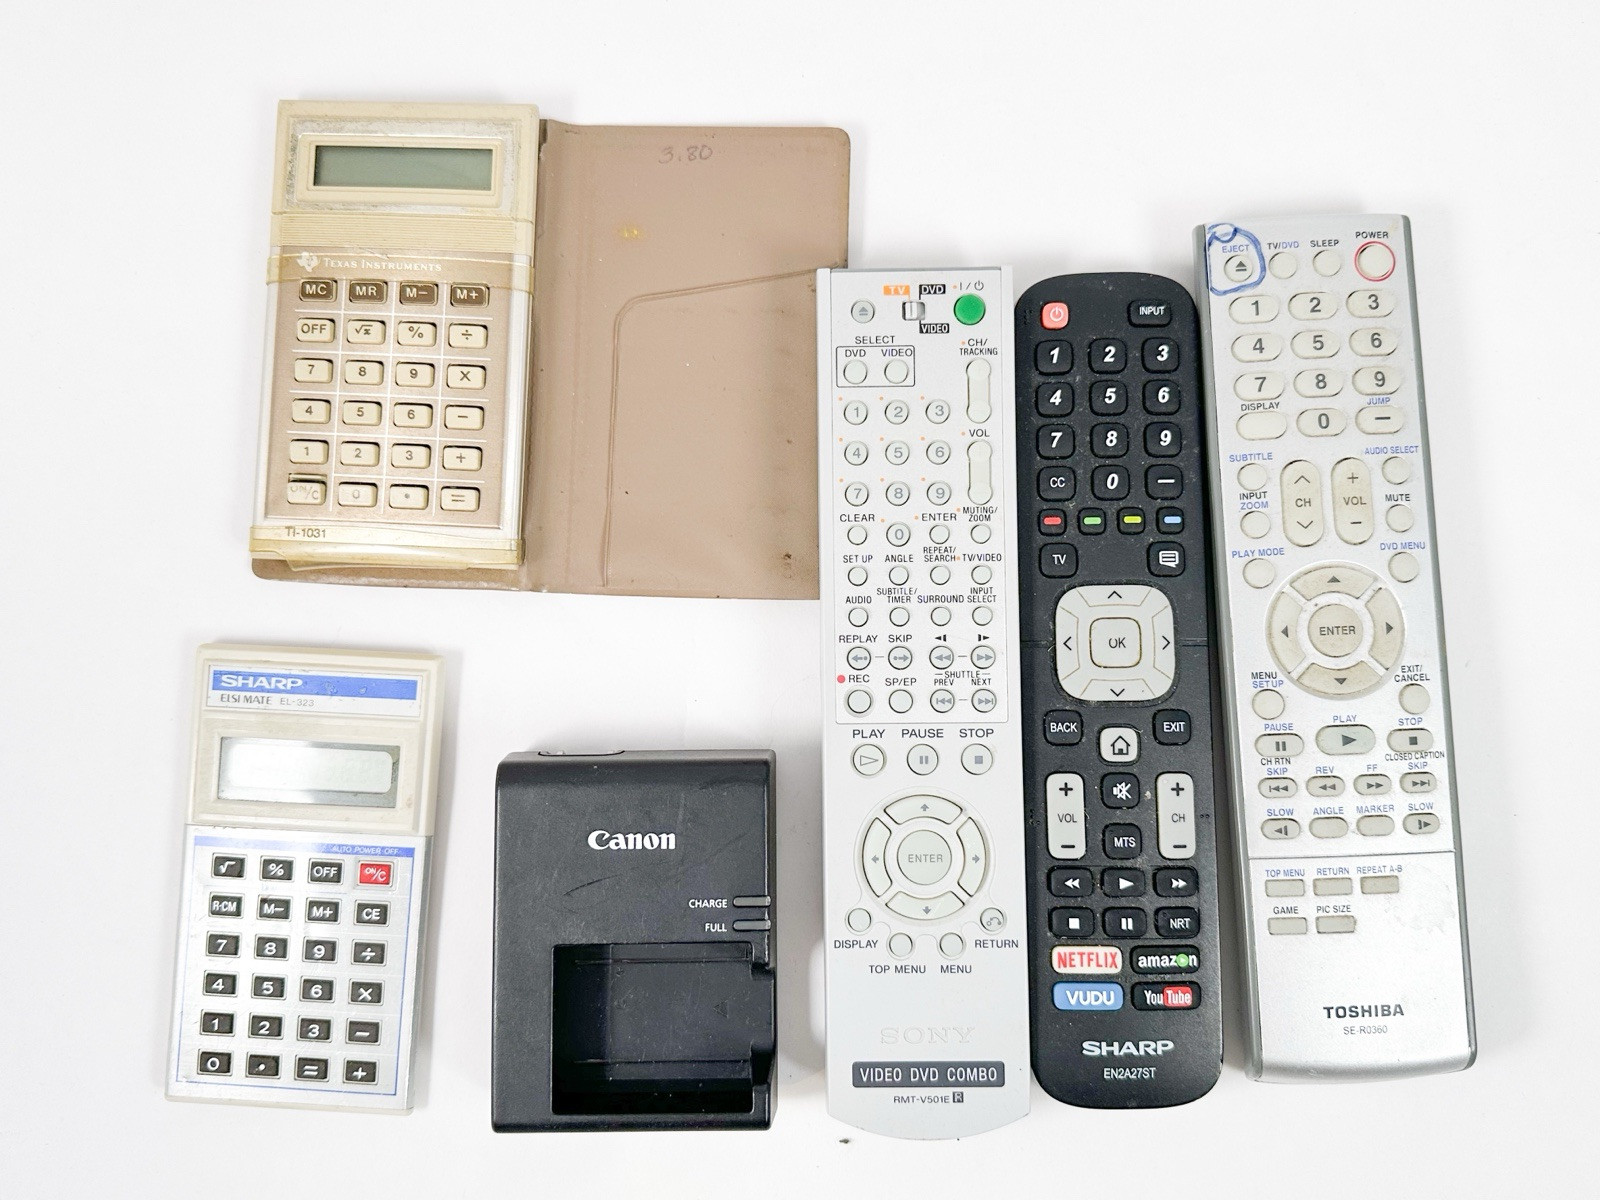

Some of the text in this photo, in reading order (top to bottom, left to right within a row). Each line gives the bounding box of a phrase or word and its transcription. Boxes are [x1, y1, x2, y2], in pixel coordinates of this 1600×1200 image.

[1355, 231, 1389, 239] POWER
[1267, 241, 1299, 250] TV/DVD
[1310, 240, 1339, 248] SLEEP
[1222, 245, 1250, 253] EJECT
[304, 284, 328, 294] MC
[355, 285, 378, 296] MR
[889, 286, 905, 294] TV
[922, 285, 944, 294] DVD
[1309, 297, 1321, 313] 2
[1368, 294, 1379, 310] 3
[1139, 307, 1165, 315] INPUT
[1251, 300, 1259, 316] 1
[301, 324, 326, 334] OFF
[922, 324, 949, 333] VIDEO
[855, 336, 895, 344] SELECT
[845, 349, 866, 357] DVD
[881, 349, 913, 357] VIDEO
[960, 348, 998, 356] TRACKING
[1050, 348, 1059, 363] 1
[1104, 346, 1115, 362] 2
[1157, 345, 1169, 361] 3
[308, 365, 314, 374] 7
[358, 366, 366, 376] 8
[410, 368, 418, 379] 9
[1367, 397, 1391, 405] JUMP
[1241, 402, 1280, 411] DISPLAY
[969, 429, 990, 437] VOL
[1364, 446, 1419, 455] AUDIO SELECT
[1229, 452, 1273, 462] SUBTITLE
[1050, 477, 1065, 487] CC
[1239, 491, 1267, 500] INPUT
[1240, 501, 1269, 510] ZOOM
[1295, 498, 1311, 507] CH
[1343, 497, 1367, 506] VOL
[840, 514, 875, 522] CLEAR
[285, 526, 326, 538] TI-1031
[1380, 543, 1398, 551] DVD
[1232, 548, 1285, 558] PLAY MODE
[843, 555, 873, 563] SET UP
[1052, 555, 1066, 564] TV
[917, 595, 964, 603] SURROUND
[967, 595, 997, 603] SELECT
[1320, 626, 1356, 635] ENTER
[839, 635, 878, 643] REPLAY
[1108, 637, 1126, 648] OK
[1251, 672, 1277, 680] MENU
[1394, 674, 1430, 682] CANCEL
[220, 674, 303, 690] SHARP
[885, 678, 916, 686] SP/EP
[1272, 680, 1284, 688] UP
[243, 694, 272, 705] MATE
[280, 698, 315, 707] EL-323
[1333, 715, 1357, 723] PLAY
[1398, 717, 1423, 725] STOP
[1050, 723, 1077, 732] BACK
[1163, 722, 1185, 732] EXIT
[1264, 723, 1293, 731] PAUSE
[852, 730, 885, 738] PLAY
[901, 729, 944, 738] PAUSE
[959, 729, 994, 738] STOP
[1385, 751, 1445, 761] CLOSED CAPTION
[1275, 757, 1291, 765] RTN
[1316, 766, 1334, 774] REV
[1408, 762, 1428, 770] SKIP
[1267, 767, 1288, 775] SKIP
[1313, 807, 1344, 815] ANGLE
[1356, 805, 1395, 813] MARKER
[1408, 802, 1433, 811] SLOW
[1267, 808, 1294, 816] SLOW
[1057, 814, 1077, 822] VOL
[1172, 814, 1185, 822] CH
[588, 830, 676, 850] Canon
[1114, 837, 1136, 847] MTS
[332, 845, 399, 855] AUTO POWER OFF
[908, 855, 943, 863] ENTER
[313, 866, 338, 877] OFF
[1265, 869, 1305, 877] TOP MENU
[1316, 867, 1350, 875] RETURN
[1356, 866, 1388, 874] REPEAT
[688, 899, 728, 908] CHARGE
[1273, 906, 1298, 914] GAME
[1333, 905, 1351, 913] SIZE
[363, 909, 380, 919] CE
[705, 923, 727, 932] FULL
[1170, 918, 1191, 928] NRT
[217, 939, 228, 951] 7
[834, 940, 878, 948] DISPLAY
[975, 940, 1018, 948] RETURN
[265, 943, 277, 955] 8
[313, 945, 325, 958] 9
[1057, 952, 1118, 968] NETFLIX
[869, 965, 926, 973] TOP MENU
[940, 965, 972, 973] MENU
[1066, 990, 1115, 1005] VUDU
[1323, 1004, 1404, 1019] TOSHIBA
[881, 1027, 976, 1044] SONY
[1082, 1040, 1174, 1056] SHARP
[860, 1067, 997, 1081] VIDEO DVD COMBO
[1104, 1068, 1156, 1079] EN2A27ST
